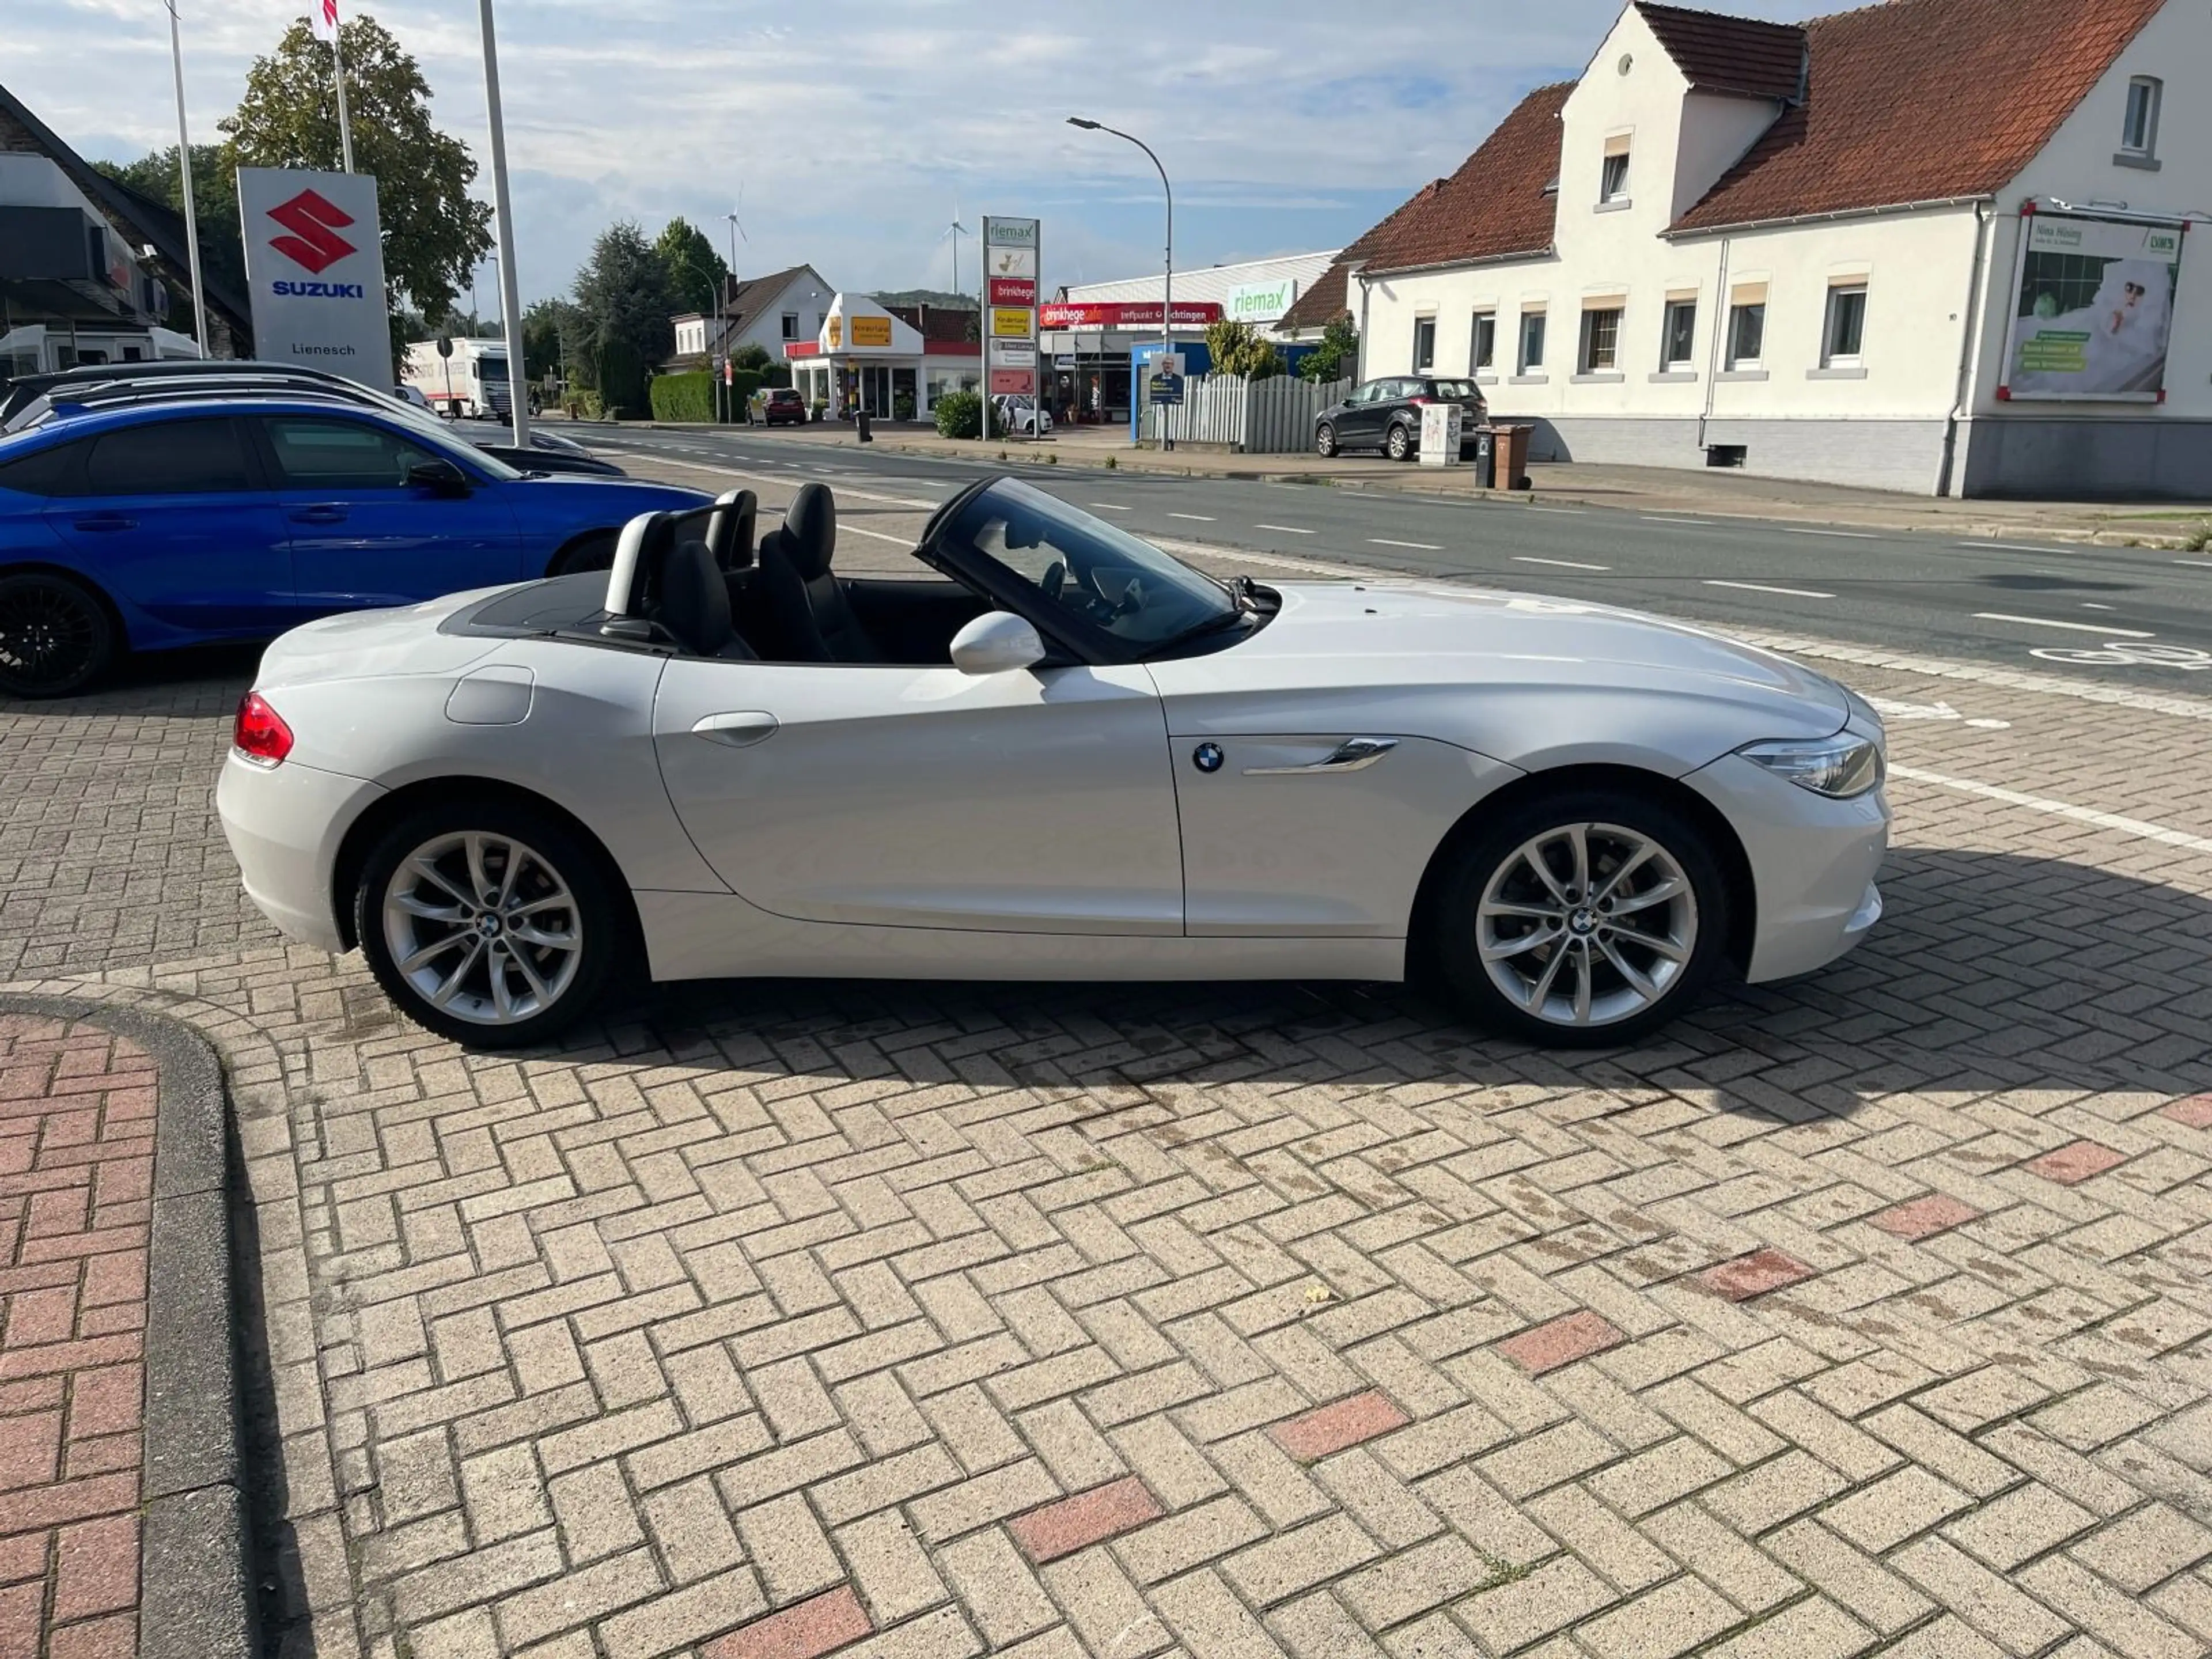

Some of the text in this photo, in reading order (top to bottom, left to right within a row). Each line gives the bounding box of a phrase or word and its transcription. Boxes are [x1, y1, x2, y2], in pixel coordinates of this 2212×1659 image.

[990, 224, 1034, 237] riemax
[272, 281, 363, 299] SUZUKI
[998, 285, 1035, 300] brinkhege
[1234, 283, 1286, 313] riemax
[1046, 306, 1085, 325] brinkhege
[1120, 310, 1153, 321] treffpunkt
[292, 343, 355, 355] Lienesch
